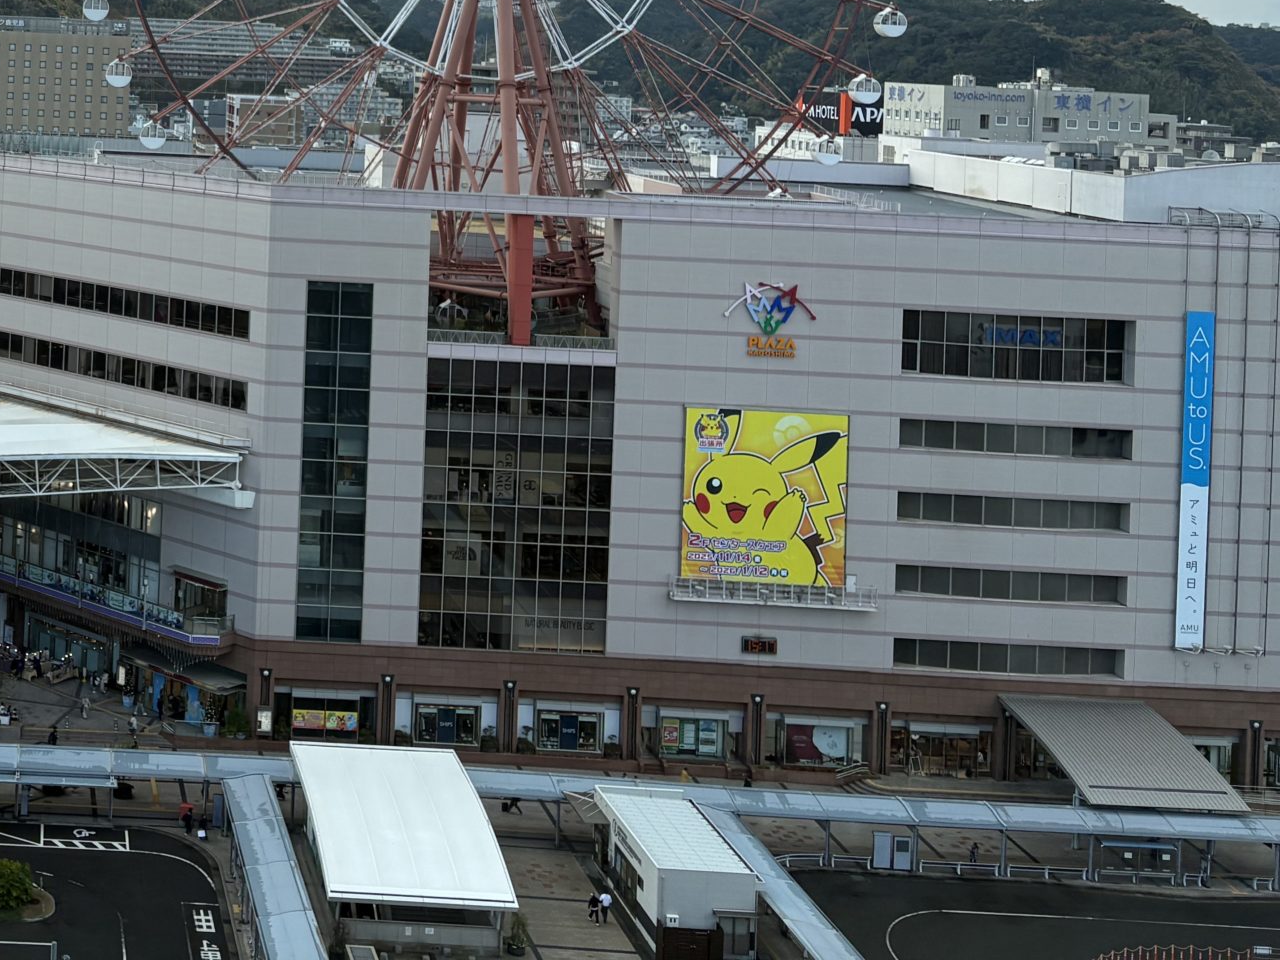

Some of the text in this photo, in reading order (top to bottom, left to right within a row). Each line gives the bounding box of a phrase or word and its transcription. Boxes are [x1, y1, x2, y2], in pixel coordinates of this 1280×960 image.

[888, 85, 925, 101] 東横イン
[953, 90, 1026, 103] toyoko-inn.com
[1054, 93, 1134, 113] 東横イン
[815, 105, 839, 120] HOTEL
[747, 336, 797, 351] PLAZA
[1188, 402, 1208, 418] to
[1180, 624, 1199, 632] AMU
